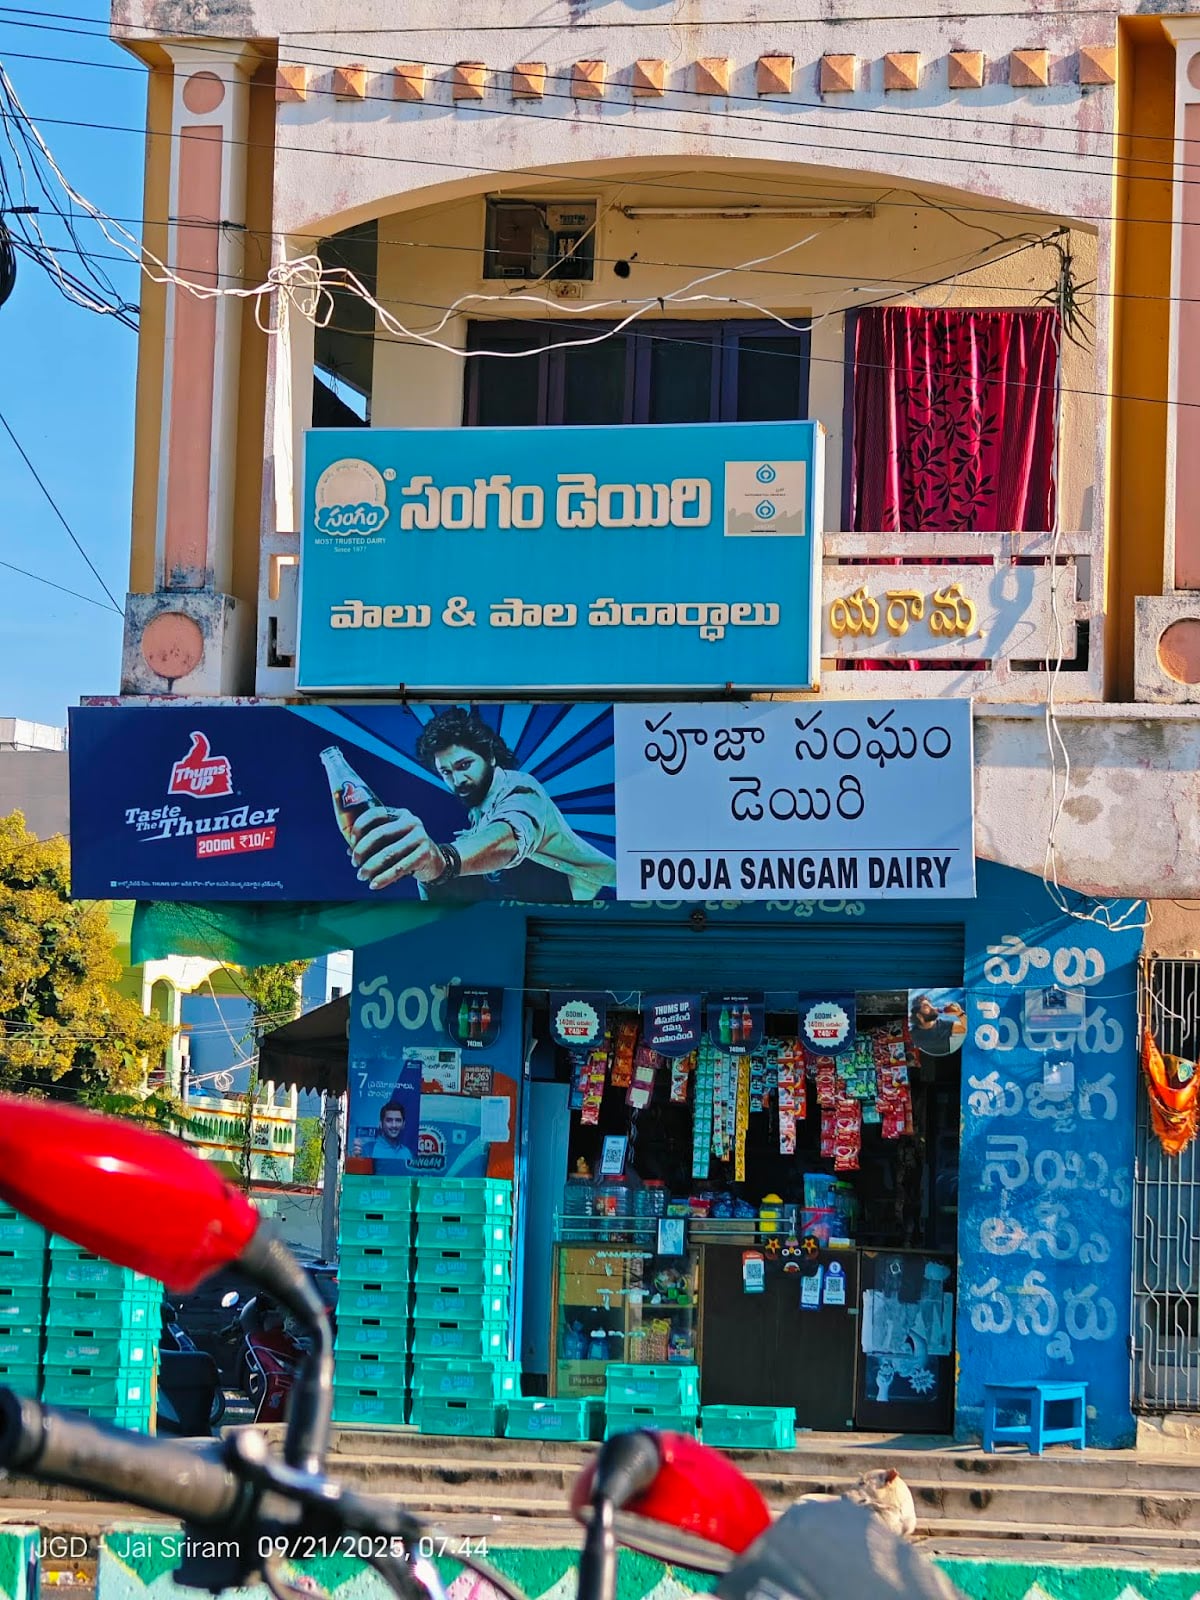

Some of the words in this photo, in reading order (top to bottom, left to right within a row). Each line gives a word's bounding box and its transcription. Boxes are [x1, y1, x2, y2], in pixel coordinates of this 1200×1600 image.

[325, 506, 378, 527] సంగం
[400, 475, 544, 530] సంగం
[556, 473, 712, 529] డెయిరి
[329, 600, 431, 629] పాలు
[442, 596, 476, 628] &
[489, 598, 577, 628] పాల
[588, 597, 780, 642] పదార్థాలు
[645, 711, 765, 775] పూజా
[794, 708, 952, 768] సంఘం
[176, 764, 226, 783] Thums
[125, 804, 181, 825] Taste
[729, 774, 865, 821] డెయిరి
[136, 821, 157, 832] The
[150, 805, 279, 840] Thunder
[198, 840, 235, 854] 200ml
[641, 858, 731, 890] POOJA
[741, 857, 858, 890] SANGAM
[869, 856, 952, 889] DAIRY
[984, 935, 1105, 987] పాలు
[655, 1003, 679, 1016] THUMS
